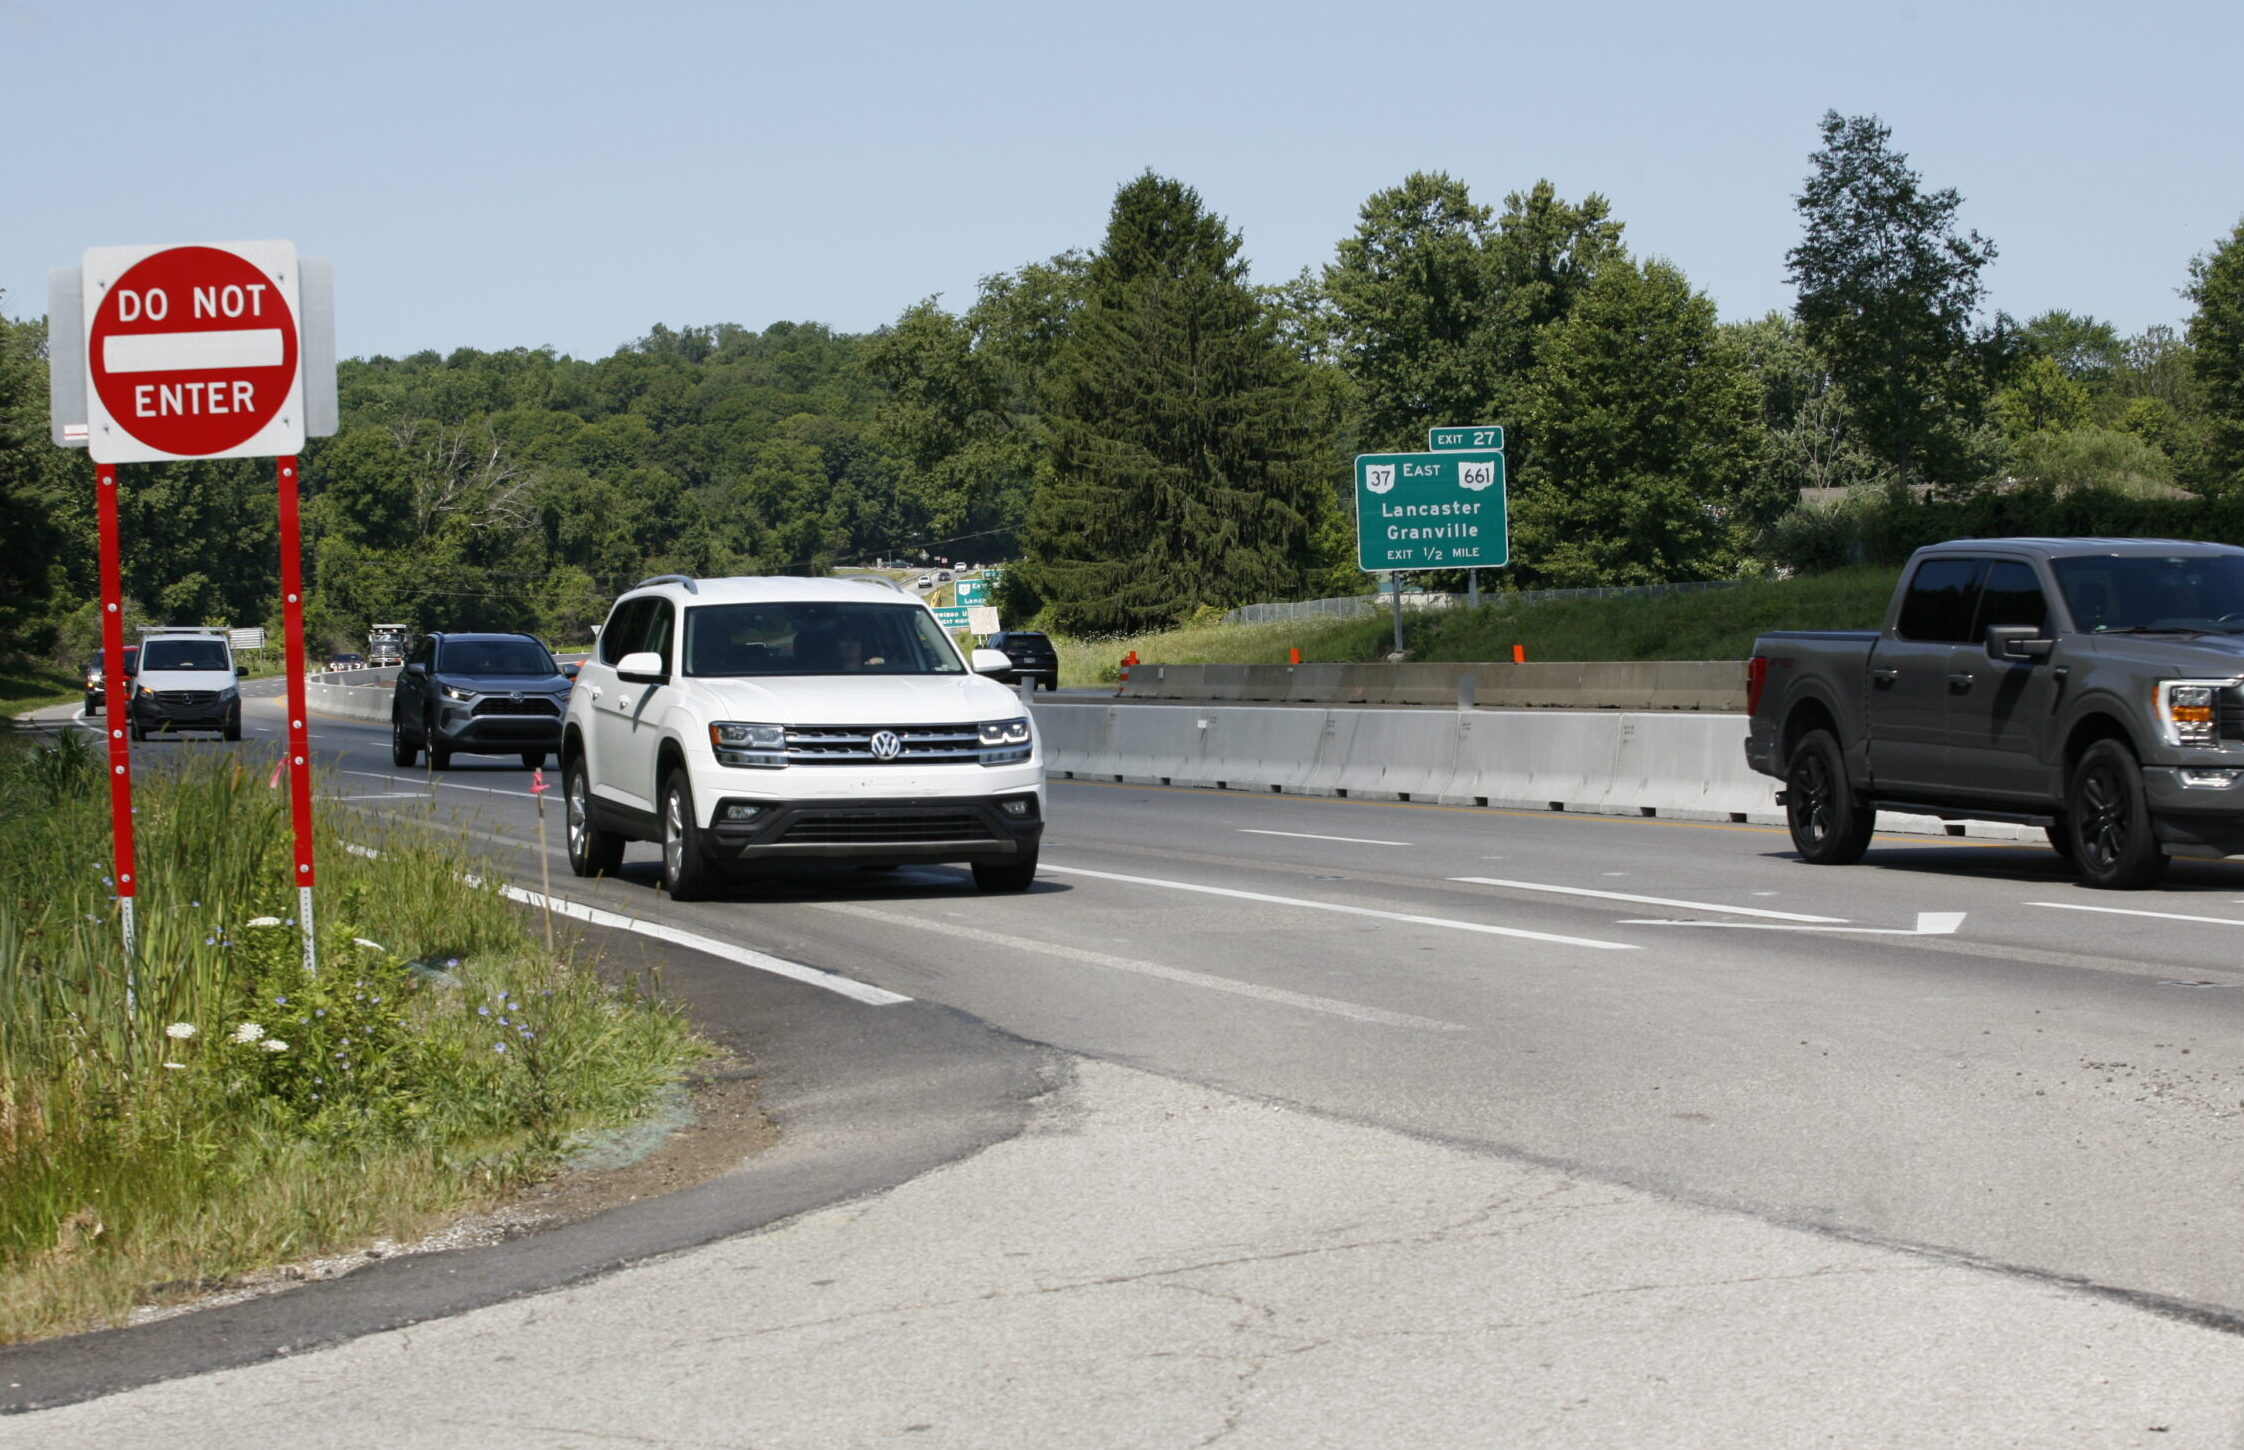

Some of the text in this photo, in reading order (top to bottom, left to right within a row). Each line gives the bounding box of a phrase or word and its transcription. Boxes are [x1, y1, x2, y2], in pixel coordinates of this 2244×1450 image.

[118, 283, 266, 322] DO NOT
[135, 380, 255, 418] ENTER
[1437, 431, 1495, 446] EXIT 27
[1371, 463, 1490, 487] 37 EAST 661
[1382, 500, 1481, 518] Lancaster
[1387, 523, 1478, 540] Granville
[1387, 549, 1413, 560] EXIT
[1452, 547, 1480, 558] MILE
